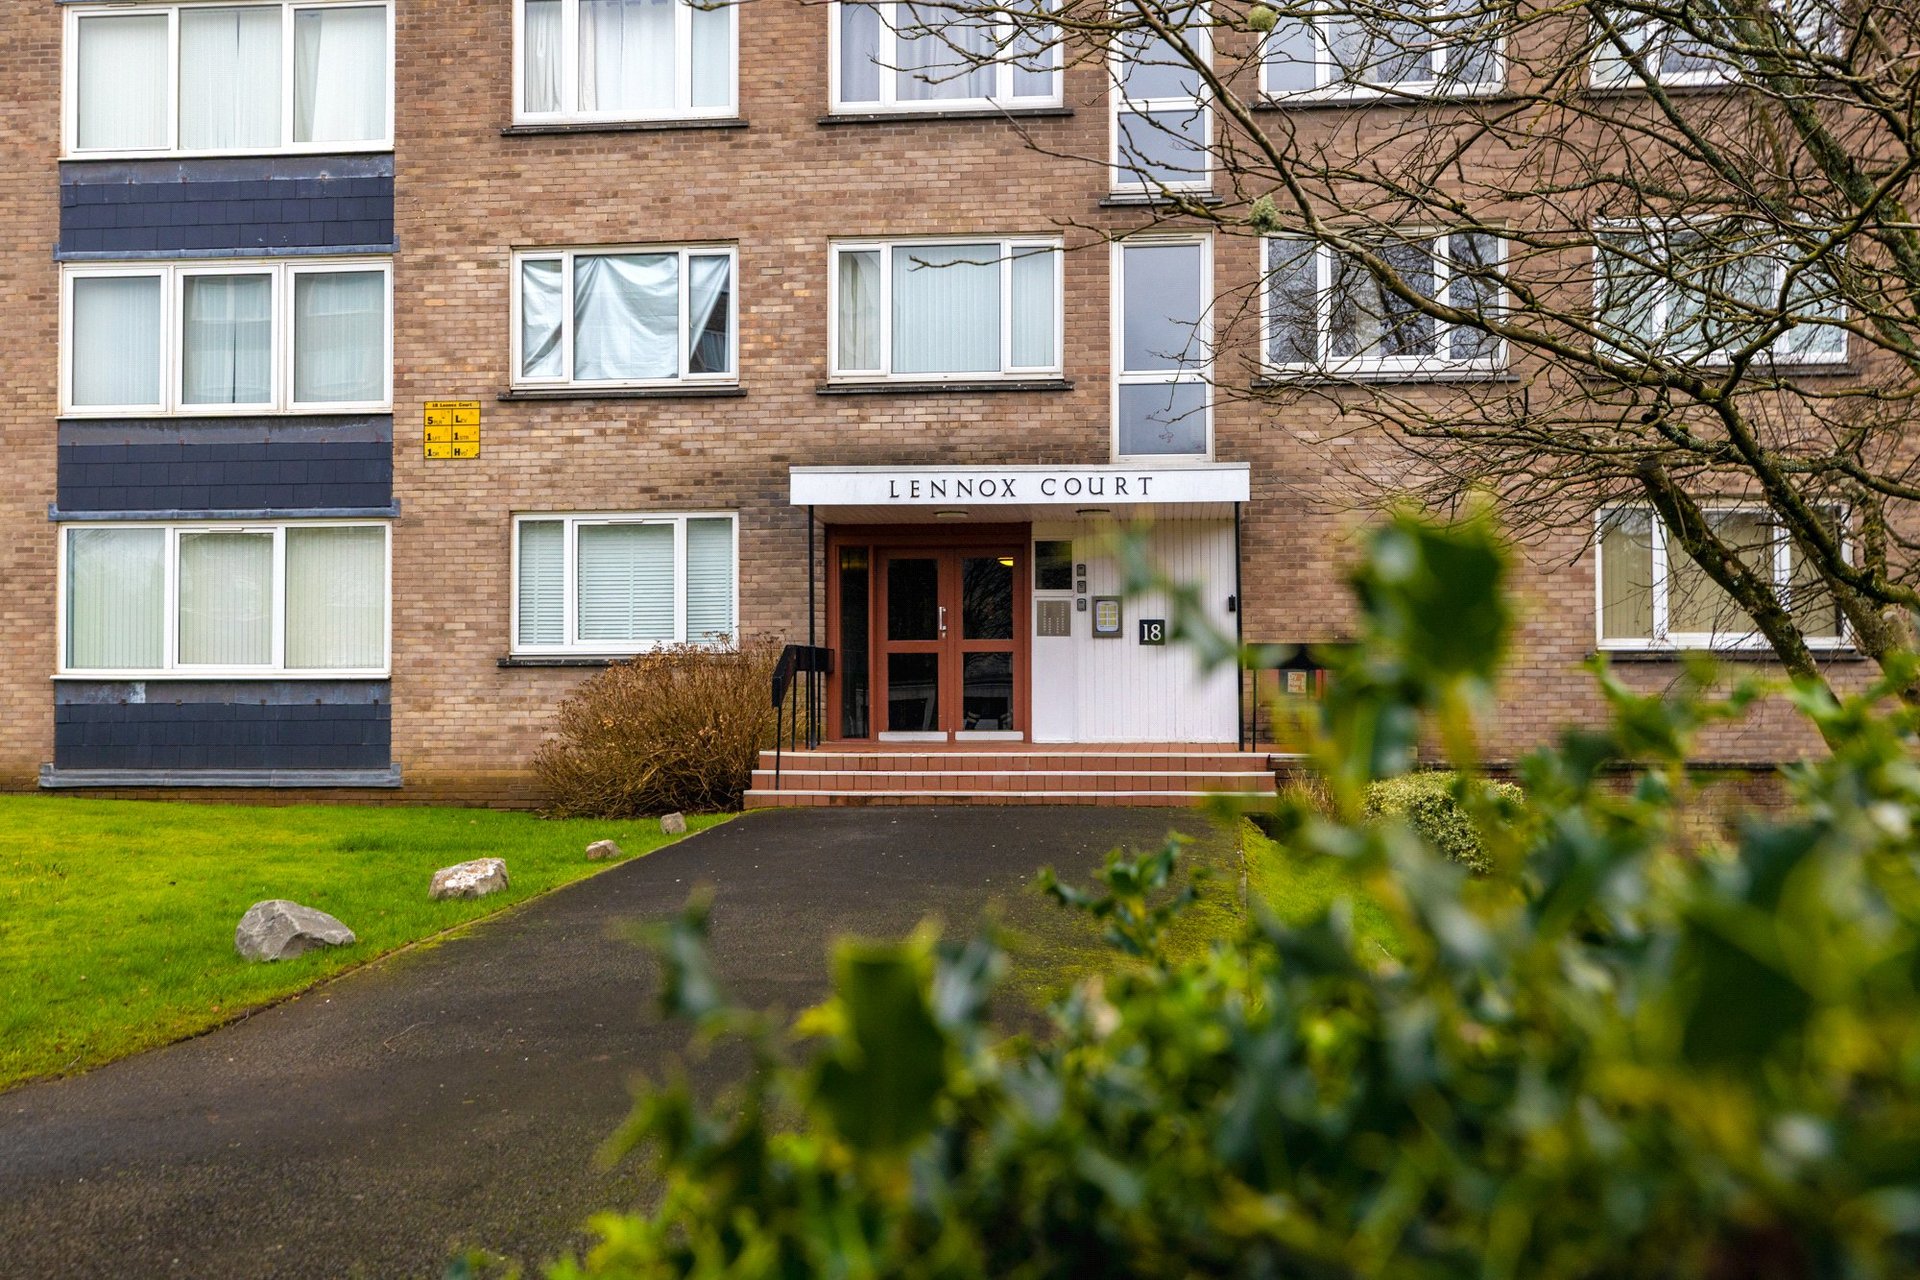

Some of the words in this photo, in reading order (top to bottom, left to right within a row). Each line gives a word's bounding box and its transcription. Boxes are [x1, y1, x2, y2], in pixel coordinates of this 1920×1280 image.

[889, 478, 1017, 498] LENNOX
[1041, 476, 1153, 496] COURT
[1142, 623, 1162, 641] 18
